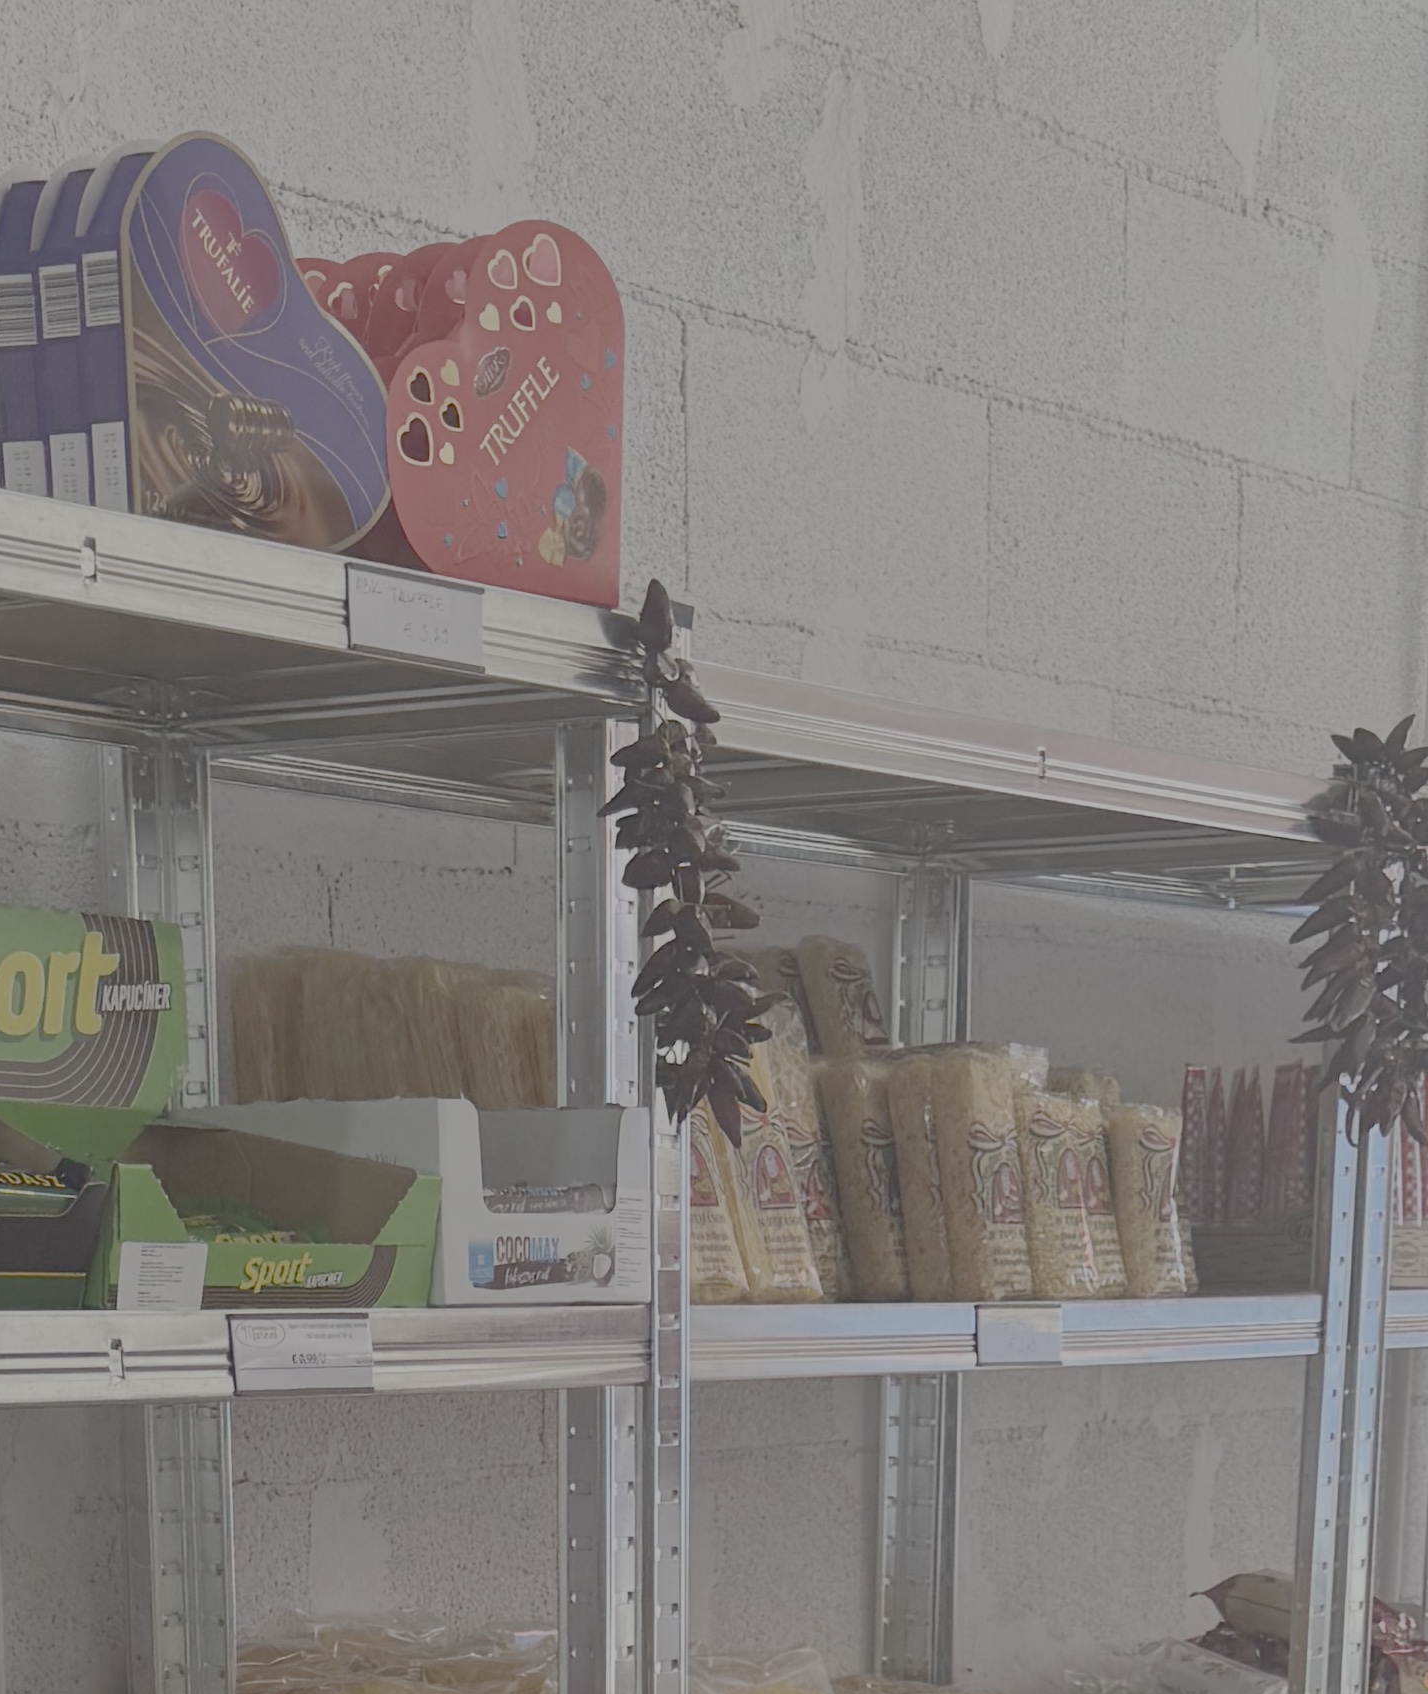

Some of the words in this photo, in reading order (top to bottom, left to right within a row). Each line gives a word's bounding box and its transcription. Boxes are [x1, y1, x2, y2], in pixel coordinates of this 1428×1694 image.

[479, 357, 560, 467] TRUFFLE
[494, 1235, 561, 1263] COCOMAX
[239, 1251, 312, 1294] Sport
